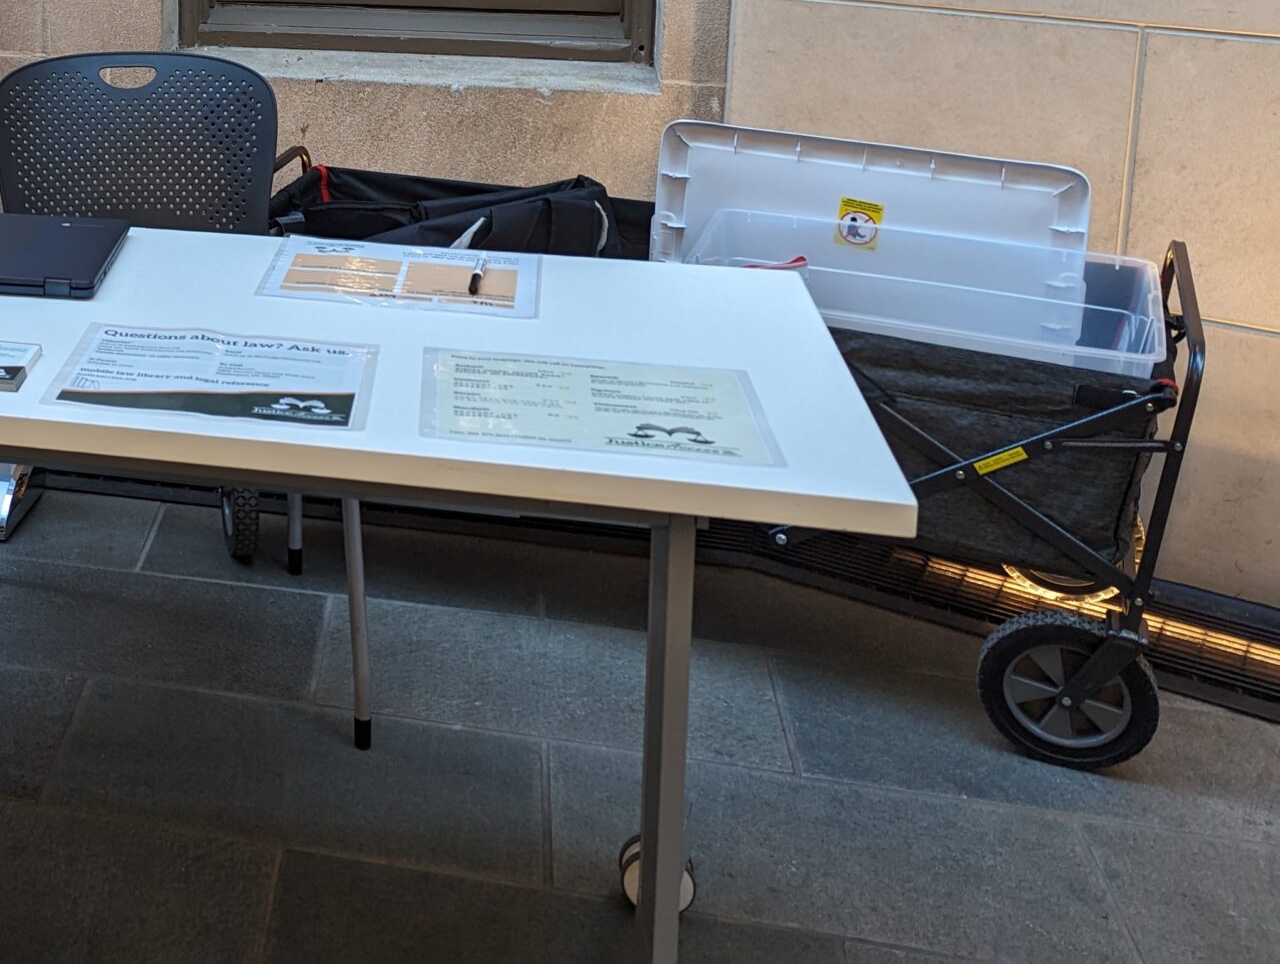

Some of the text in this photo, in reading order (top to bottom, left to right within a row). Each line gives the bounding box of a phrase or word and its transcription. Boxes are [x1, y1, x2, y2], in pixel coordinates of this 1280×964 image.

[104, 329, 187, 340] Questions
[190, 334, 238, 348] about
[242, 340, 283, 349] law?
[287, 344, 322, 354] Ask
